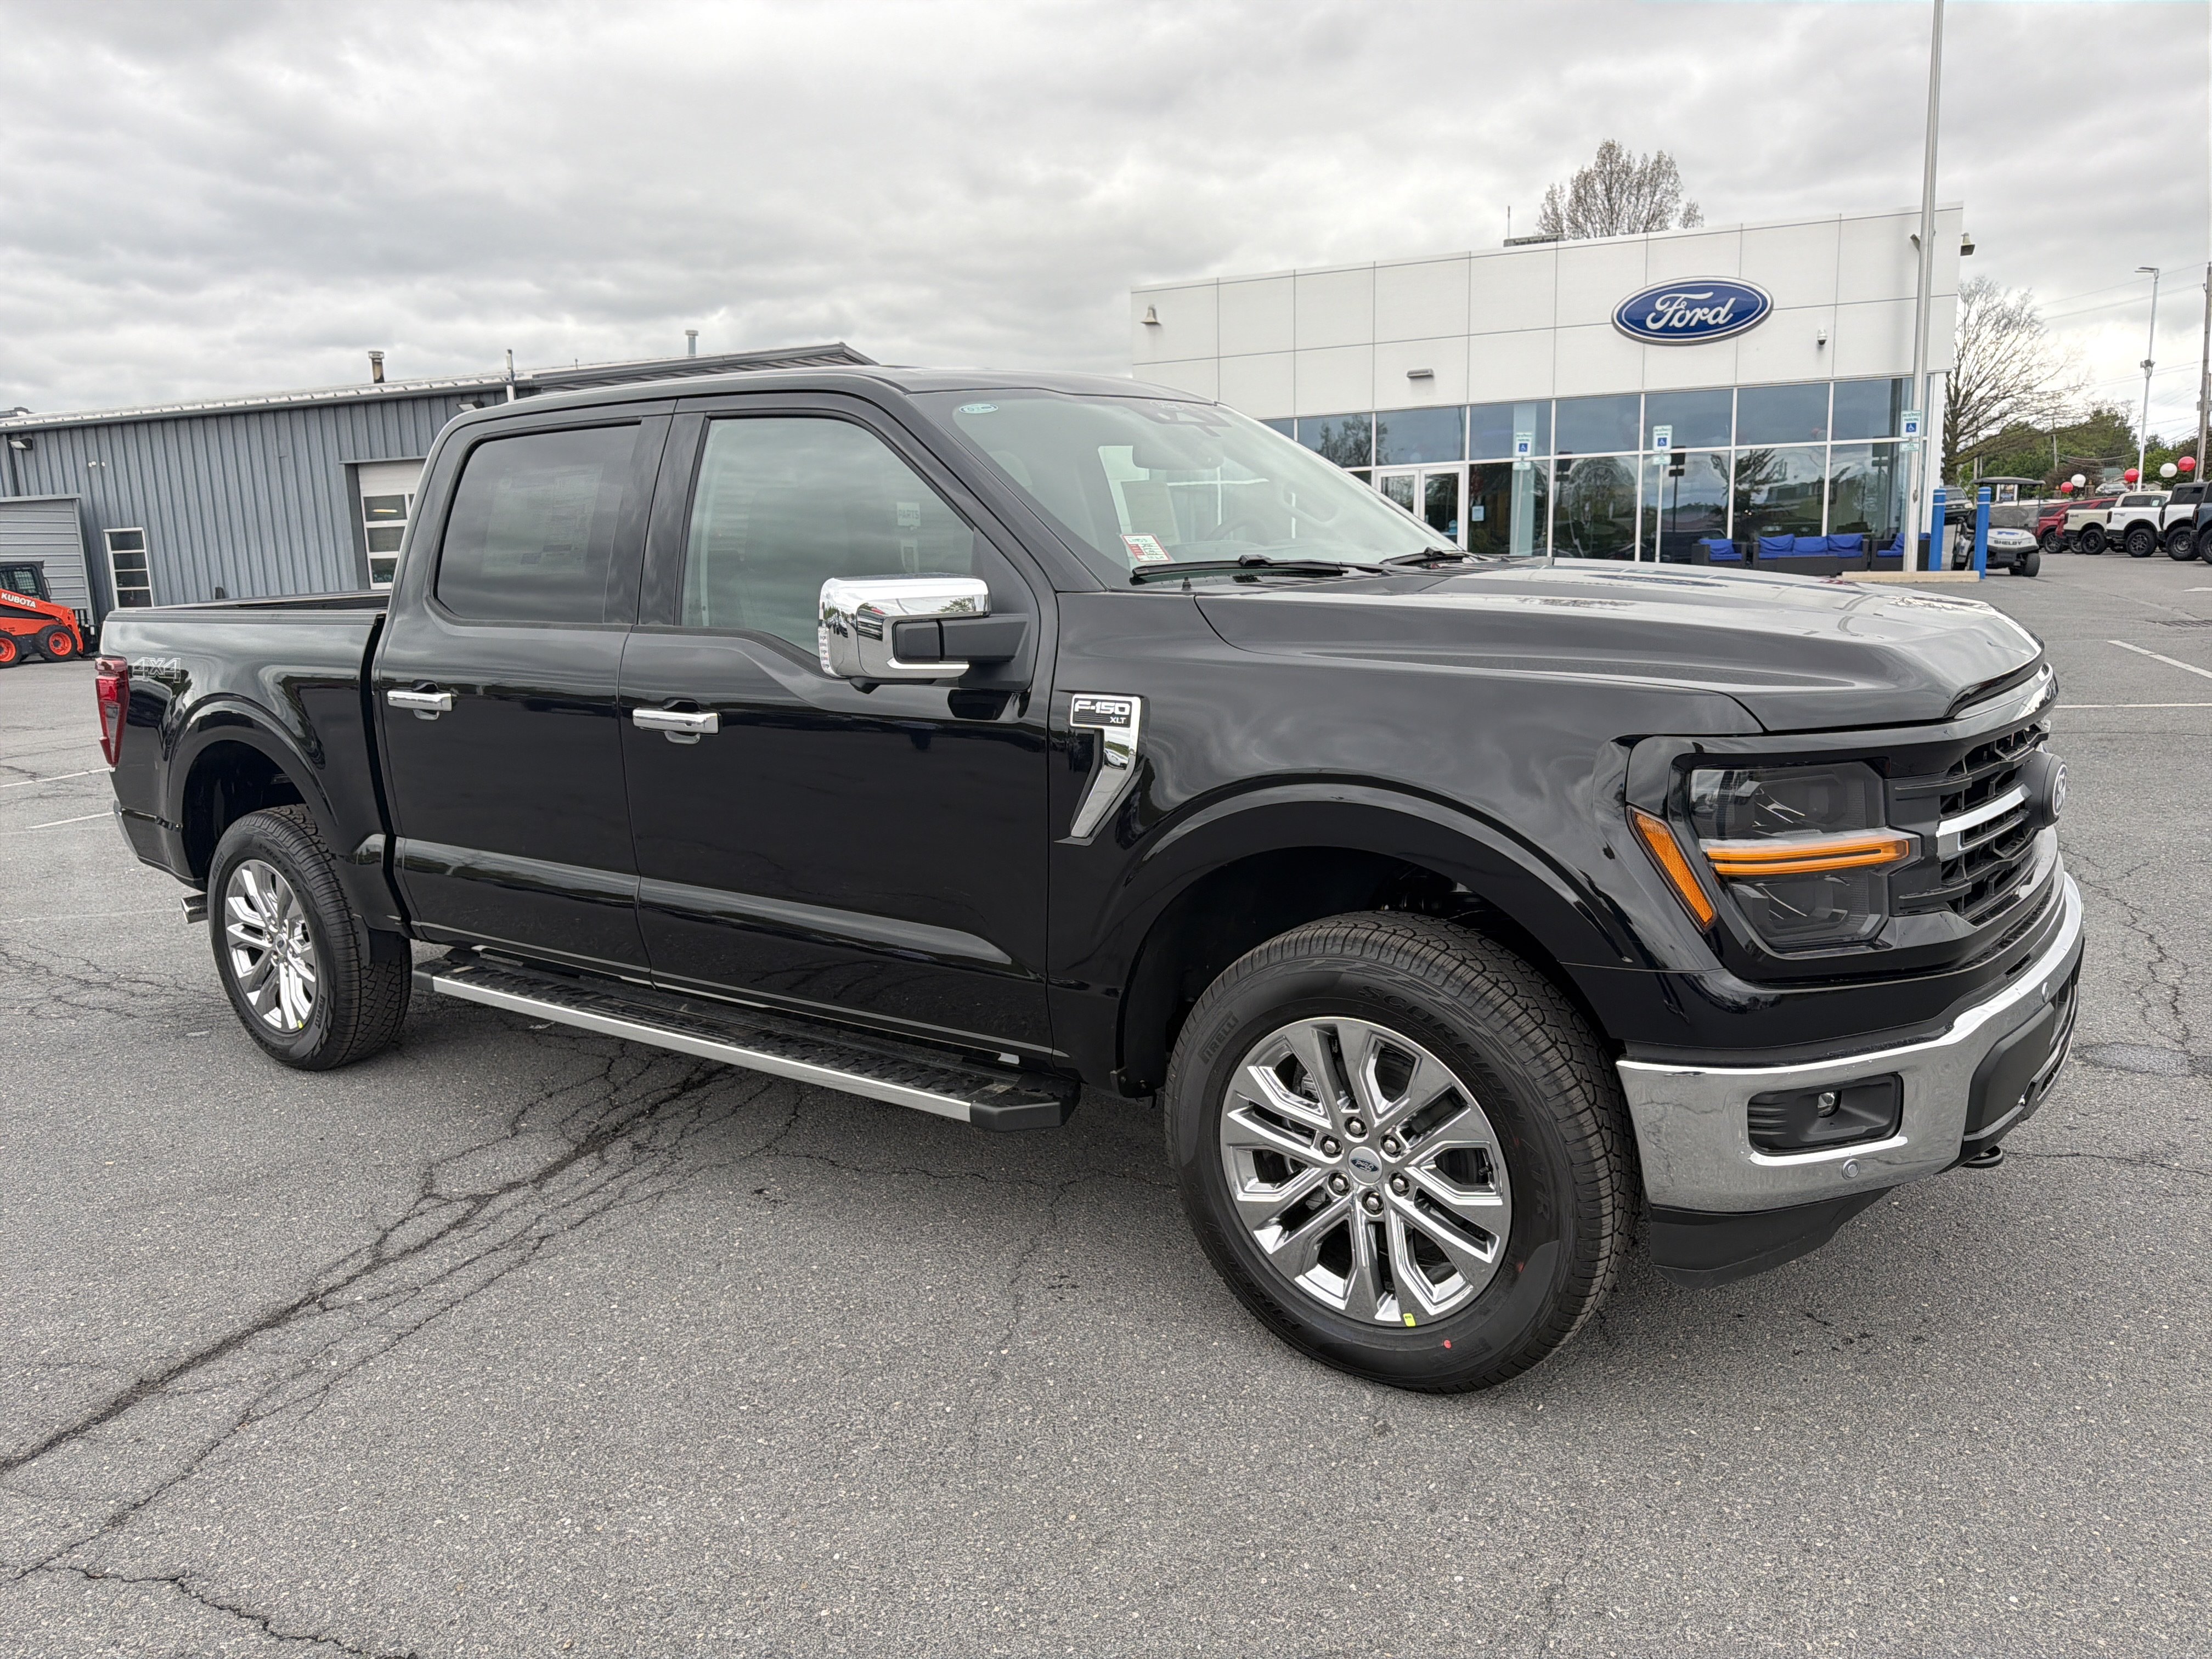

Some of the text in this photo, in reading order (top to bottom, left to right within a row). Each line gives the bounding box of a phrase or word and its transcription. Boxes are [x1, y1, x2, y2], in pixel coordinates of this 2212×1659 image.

[1646, 291, 1736, 330] Ford
[1, 592, 36, 608] KUBOTA
[1074, 701, 1130, 715] F-150
[1198, 1011, 1239, 1064] PIRELLI
[1358, 985, 1527, 1123] SCORPION
[1356, 1159, 1375, 1172] Ford
